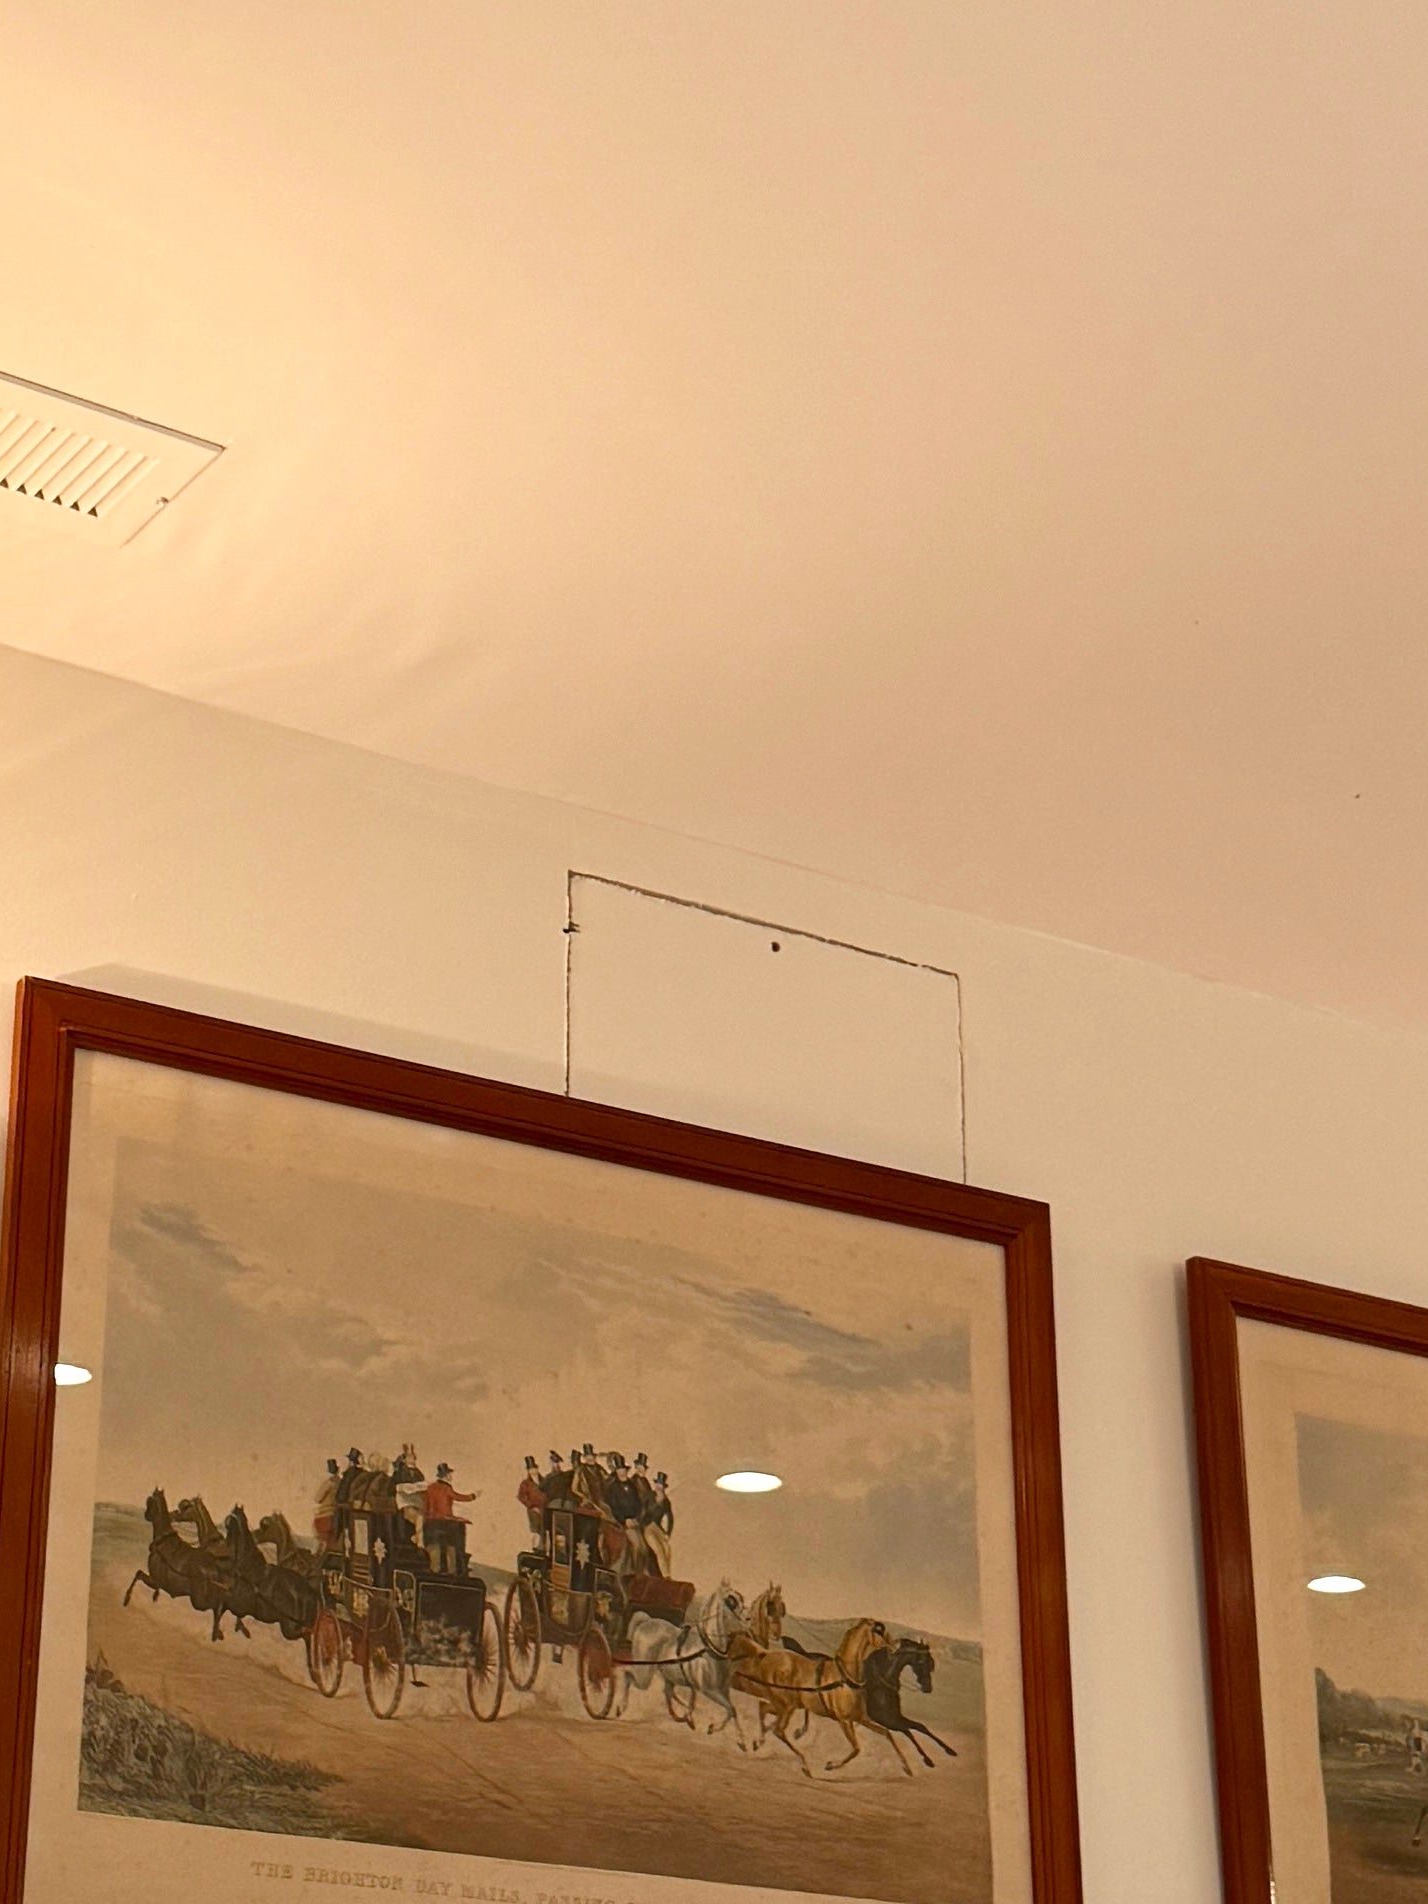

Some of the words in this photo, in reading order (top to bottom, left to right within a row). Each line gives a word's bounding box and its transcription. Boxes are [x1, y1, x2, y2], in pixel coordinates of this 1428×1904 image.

[251, 1861, 293, 1879] THE
[303, 1867, 403, 1891] BRIGHTON
[414, 1879, 452, 1896] DAY
